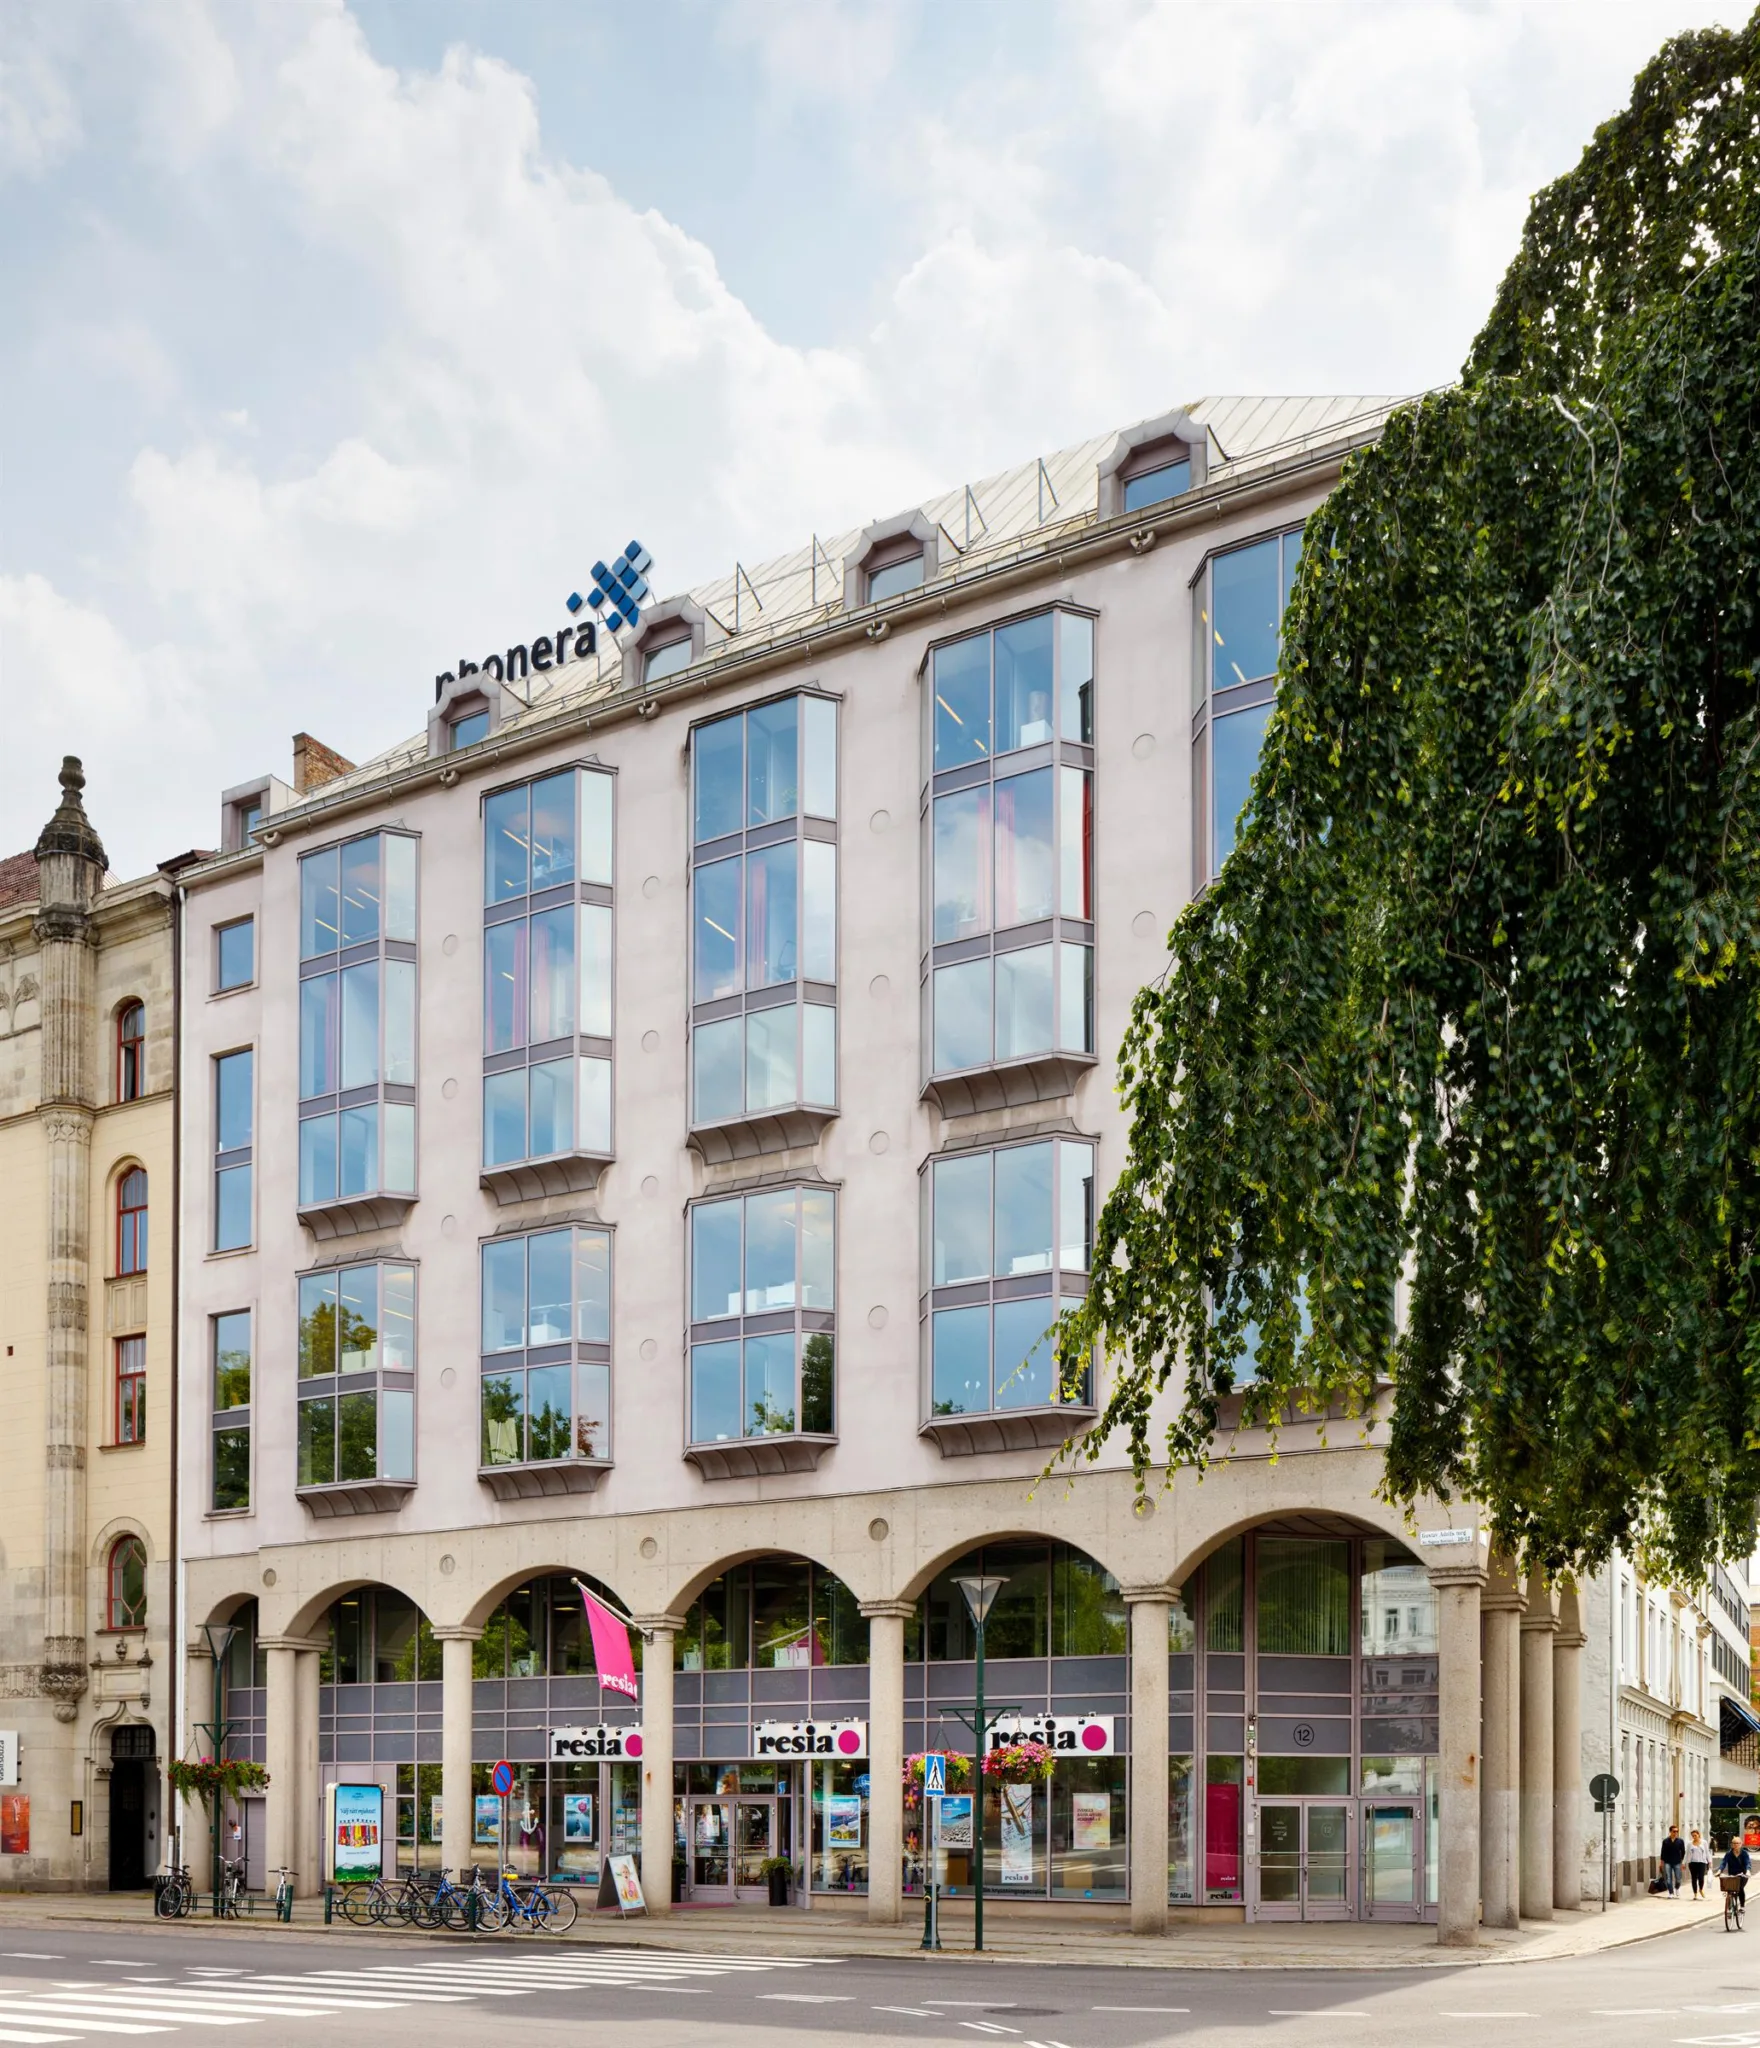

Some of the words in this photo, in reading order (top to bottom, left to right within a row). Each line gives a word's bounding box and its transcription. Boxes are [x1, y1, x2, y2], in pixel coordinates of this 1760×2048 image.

[601, 1673, 634, 1695] resia
[554, 1729, 622, 1756] resia
[757, 1725, 834, 1754] resia
[990, 1720, 1078, 1750] resia
[1298, 1729, 1310, 1741] 12
[1210, 1891, 1232, 1899] resia
